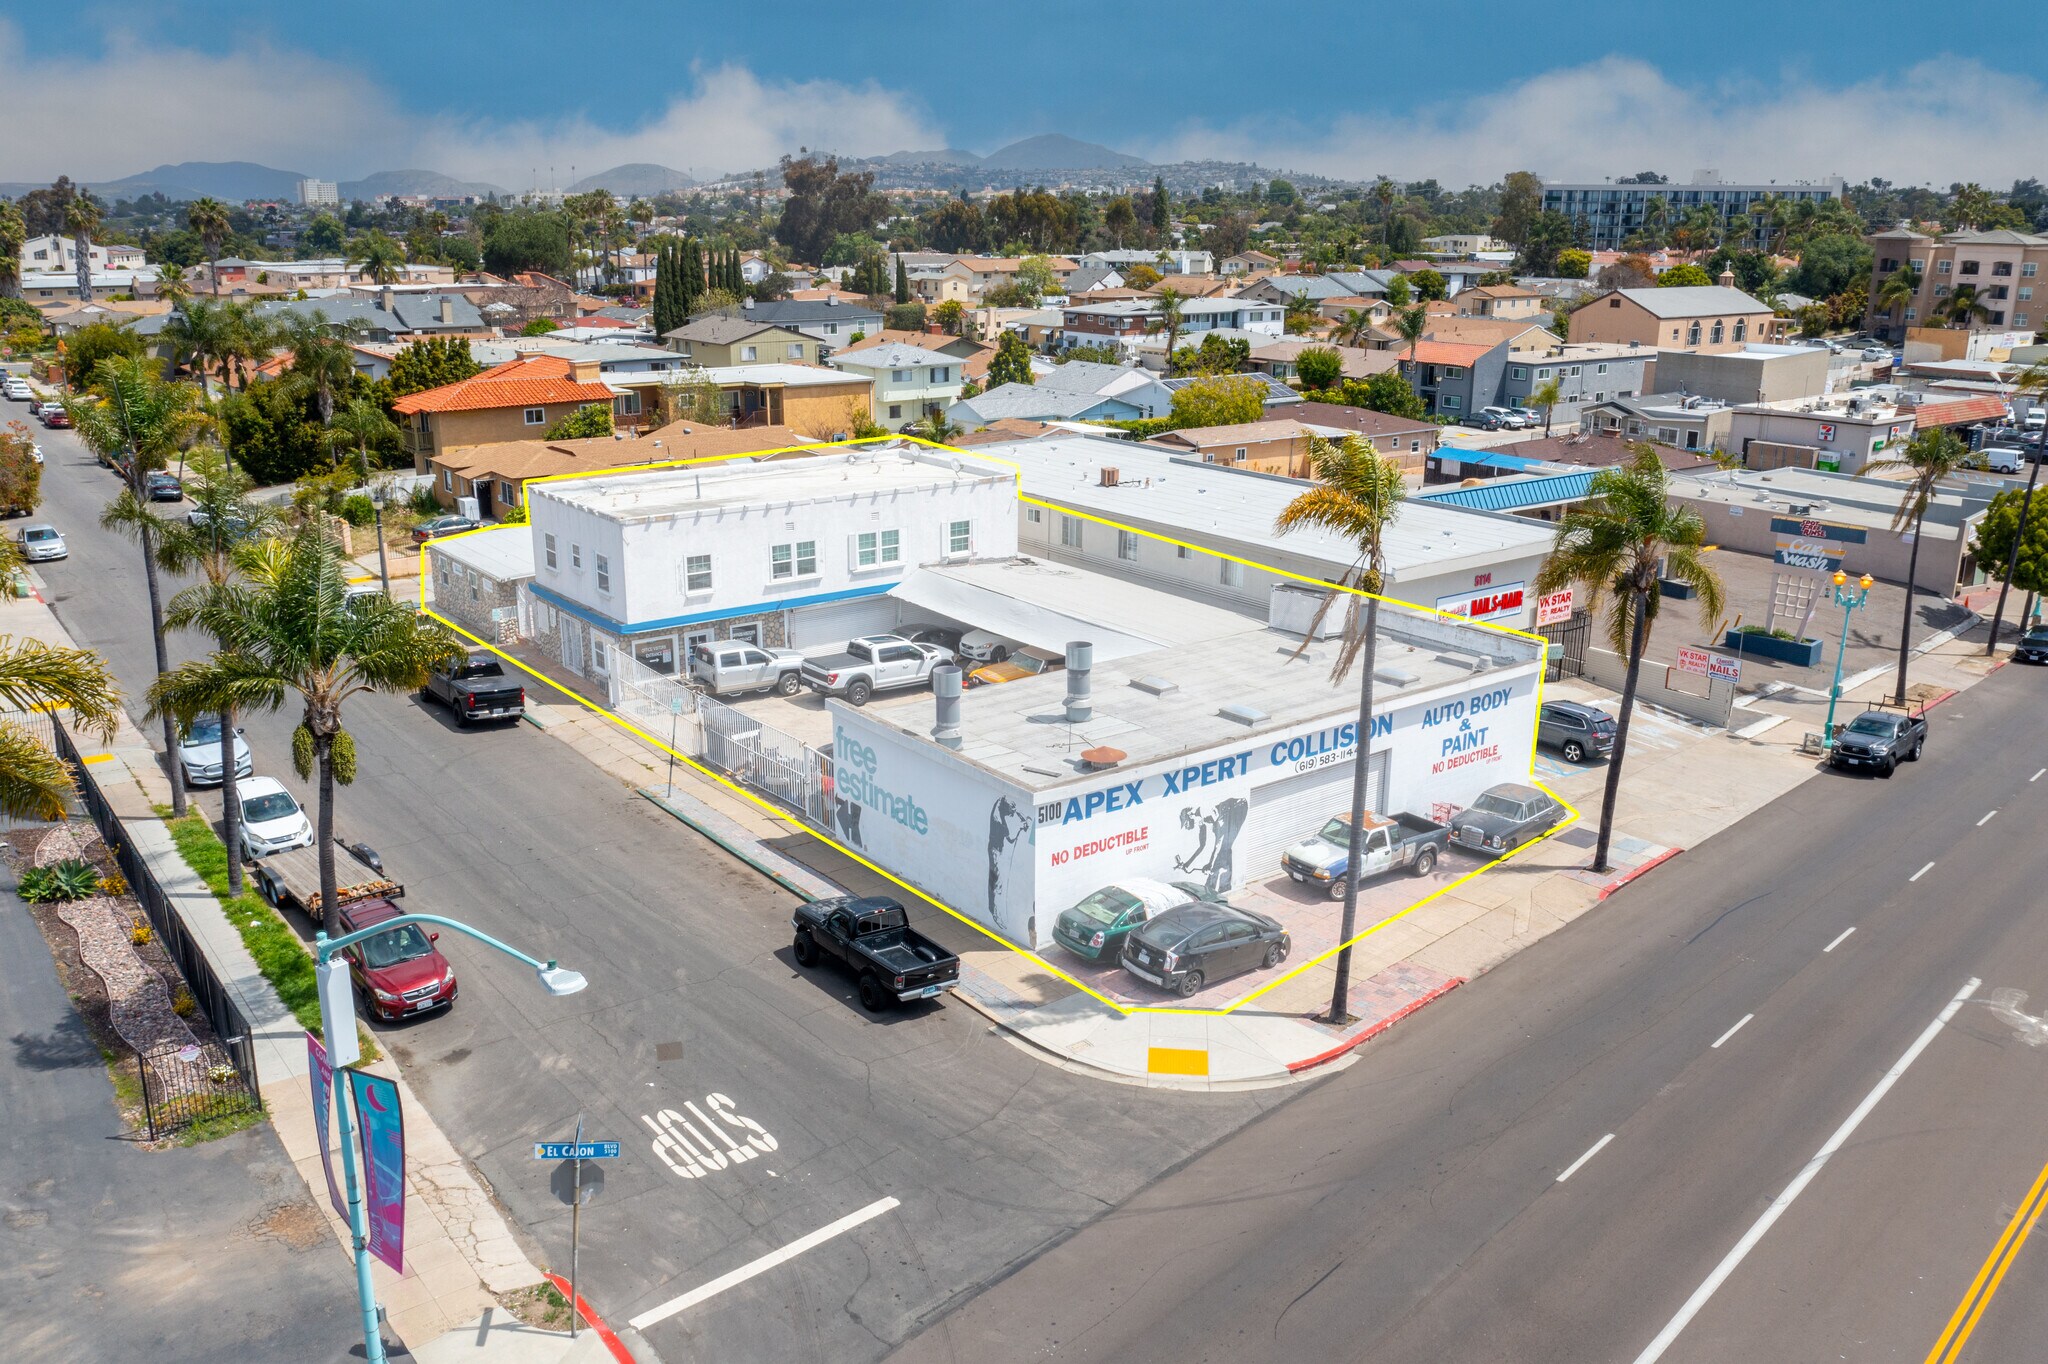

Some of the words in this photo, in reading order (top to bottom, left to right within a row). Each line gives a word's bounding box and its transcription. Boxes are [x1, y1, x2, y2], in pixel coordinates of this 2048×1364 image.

[1789, 539, 1823, 556] Car
[1540, 597, 1550, 608] VK
[1551, 592, 1572, 606] STAR
[1550, 604, 1570, 614] REALTY
[1680, 650, 1688, 658] VK
[1690, 652, 1707, 662] STAR
[1688, 660, 1706, 669] REALTY
[1709, 663, 1739, 677] NAILS
[1422, 700, 1465, 729] AUTO
[1470, 687, 1512, 715] BODY
[1459, 718, 1471, 732] &
[836, 725, 877, 774] free
[1442, 727, 1489, 757] PAINT
[1295, 756, 1318, 773] (619)
[1432, 761, 1445, 775] NO
[1447, 744, 1499, 770] DEDUCTIBLE
[1062, 779, 1144, 826] APEX
[1162, 751, 1253, 798] XPERT
[837, 767, 929, 835] estimate
[1038, 801, 1062, 824] 5100
[1051, 850, 1069, 867] NO
[1073, 826, 1149, 860] DEDUCTIBLE
[1125, 847, 1133, 856] UP
[1133, 843, 1150, 853] FRONT
[641, 1092, 779, 1179] STOP
